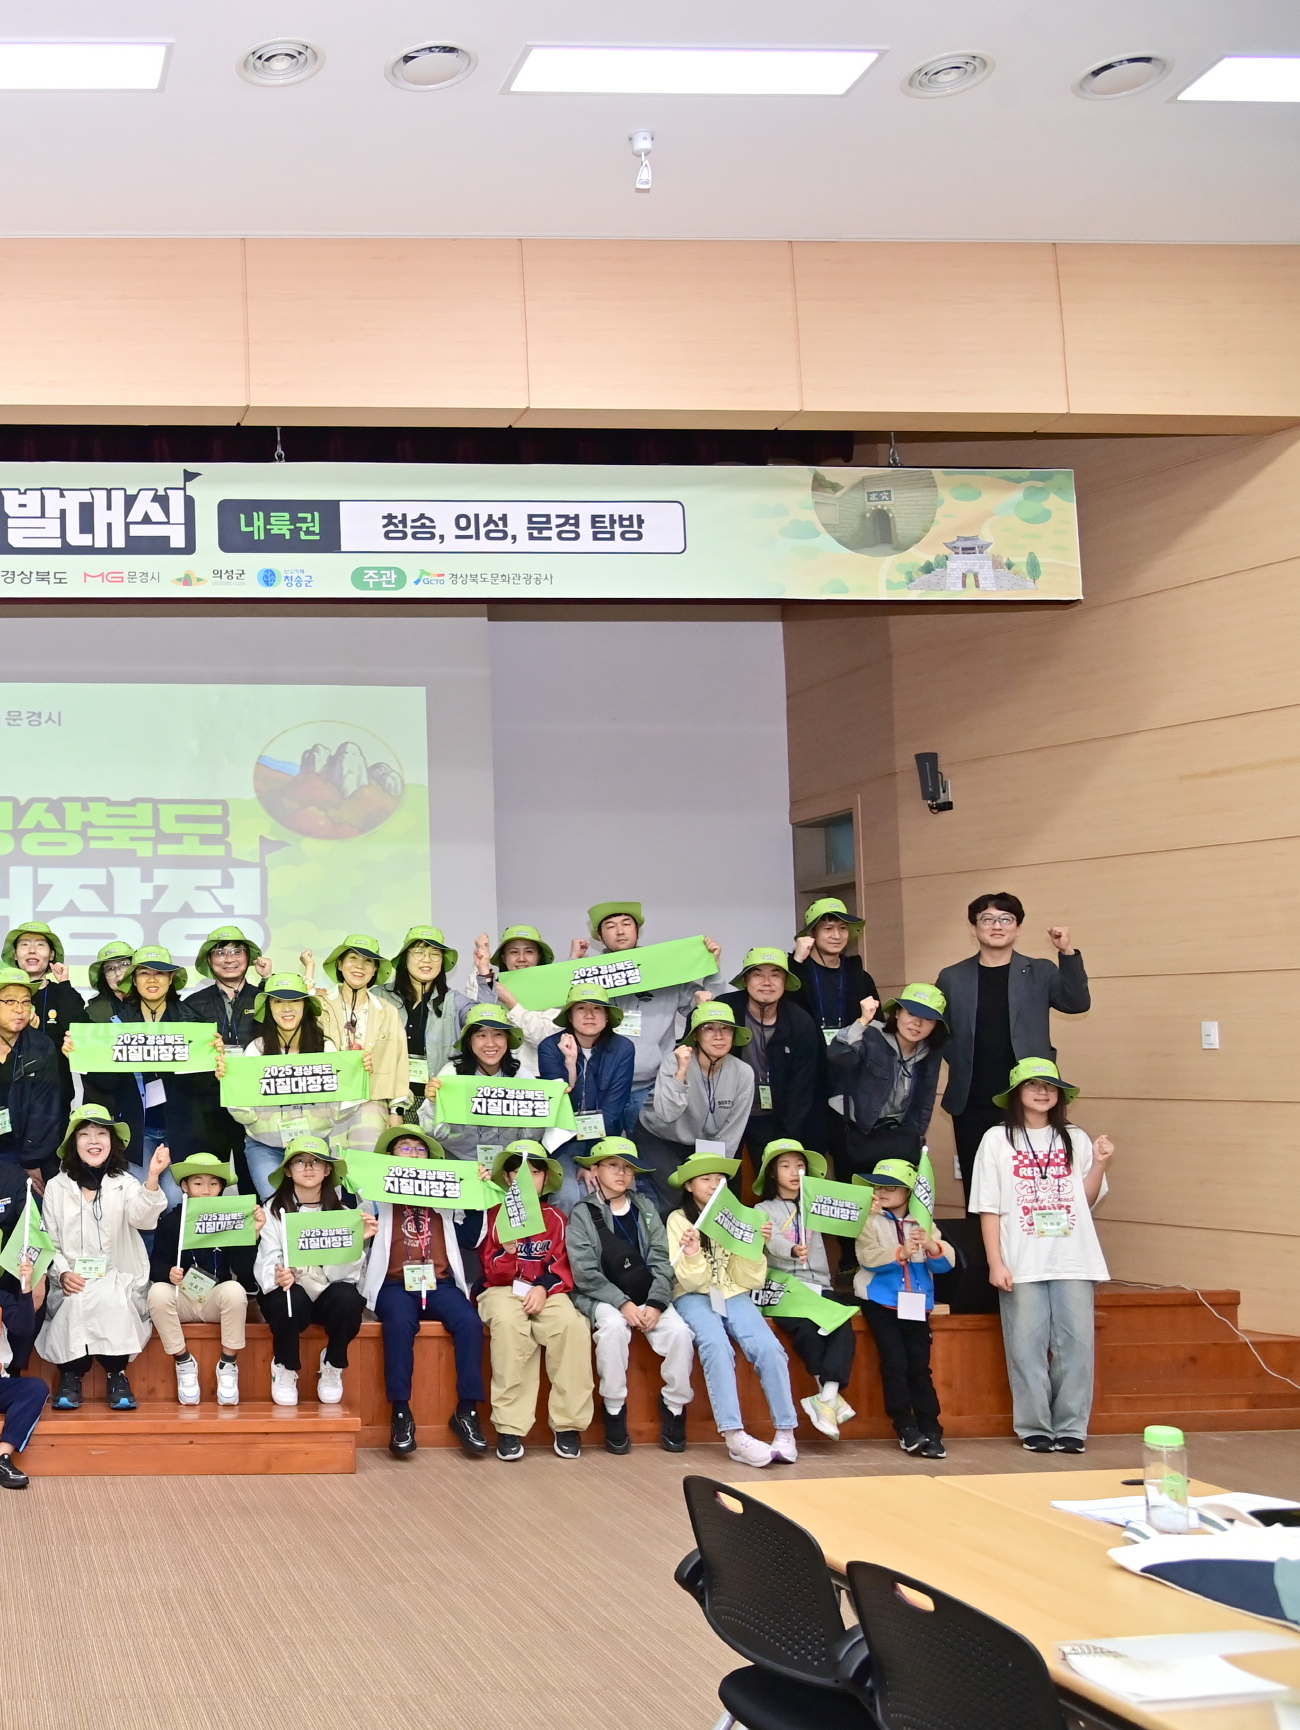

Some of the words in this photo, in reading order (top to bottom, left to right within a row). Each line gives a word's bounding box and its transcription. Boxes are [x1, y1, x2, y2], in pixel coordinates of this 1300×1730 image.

[1, 488, 186, 549] 발대식
[240, 511, 320, 540] 내륙권
[382, 513, 445, 544] 청송,
[454, 513, 517, 544] 의성,
[526, 513, 580, 541] 문경
[590, 513, 645, 541] 탐방
[0, 569, 68, 586] 경상북도
[83, 571, 124, 583] MG
[126, 571, 160, 584] 문경시
[211, 568, 246, 581] 의성군
[283, 574, 314, 588] 청송군
[362, 569, 397, 588] 주관
[448, 572, 553, 586] 경상북도문화관광공사
[4, 710, 62, 727] 문경시
[116, 1033, 145, 1046] 2025
[145, 1034, 184, 1046] 경상북도
[111, 1044, 189, 1062] 지질대장정
[263, 1064, 293, 1079] 2025
[292, 1063, 332, 1077] 경상북도
[259, 1073, 338, 1095] 지질대장정
[476, 1086, 506, 1099] 2025
[505, 1089, 545, 1100] 경상북도
[471, 1097, 550, 1117] 지질대장정
[388, 1166, 418, 1179] 2025
[417, 1169, 457, 1181] 경상북도
[383, 1175, 460, 1199] 지질대장정
[809, 1202, 860, 1222] 지질대장정
[194, 1219, 245, 1235] 지질대장정
[297, 1234, 354, 1251] 지질대장정
